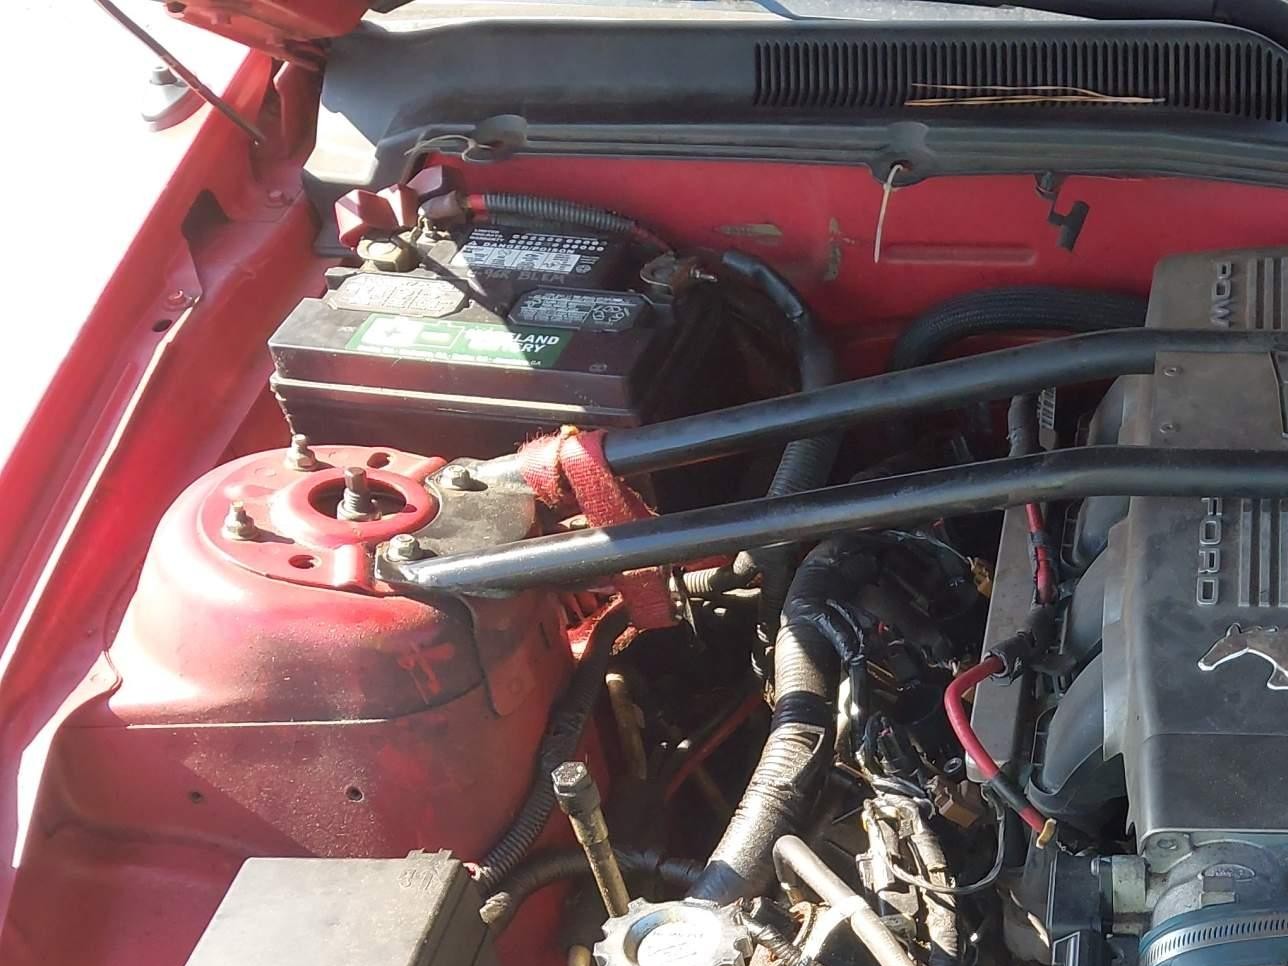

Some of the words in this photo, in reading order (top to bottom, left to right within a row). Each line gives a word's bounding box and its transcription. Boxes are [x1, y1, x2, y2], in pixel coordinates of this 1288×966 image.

[482, 242, 575, 254] DANGER/POISON
[1210, 262, 1232, 328] POW
[1195, 496, 1223, 607] FORD
